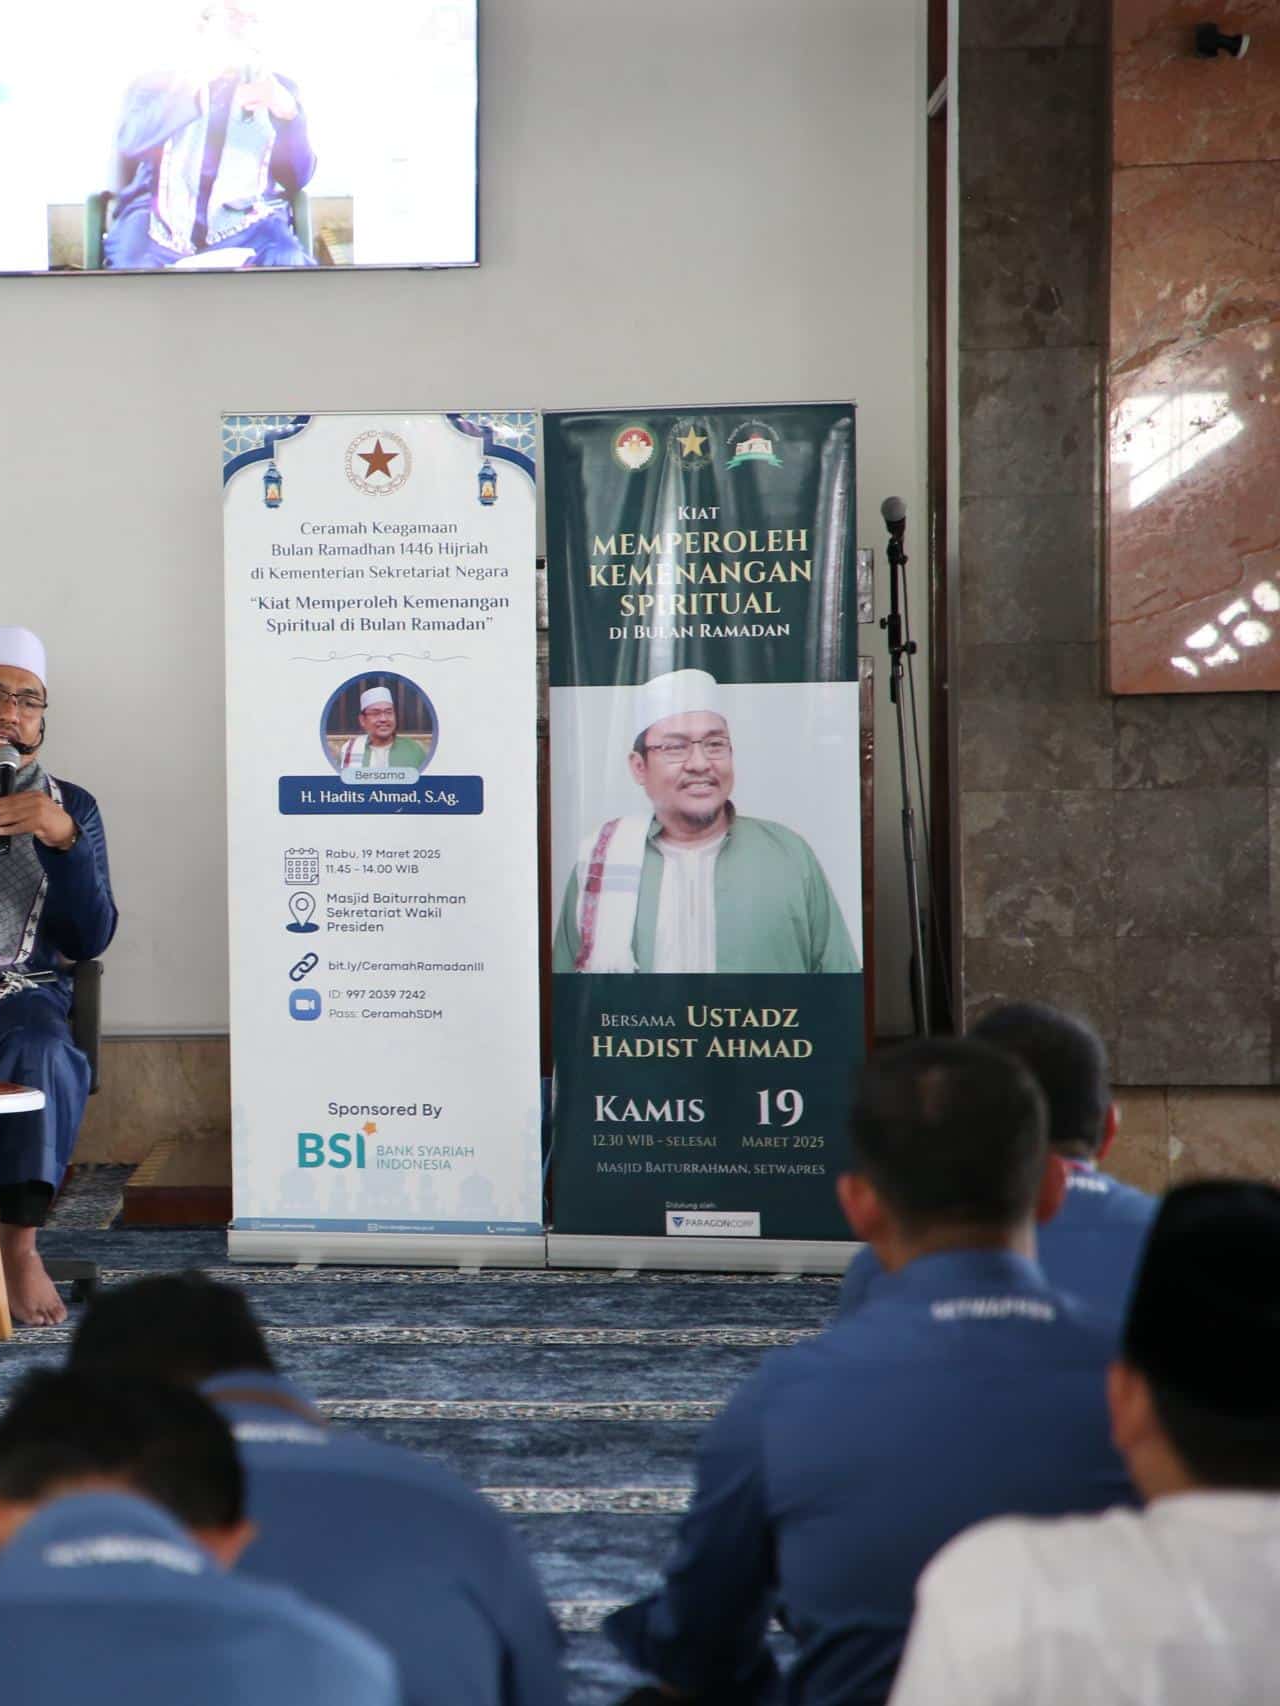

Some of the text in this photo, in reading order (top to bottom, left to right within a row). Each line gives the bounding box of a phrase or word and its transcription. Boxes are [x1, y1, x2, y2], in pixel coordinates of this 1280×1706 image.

[300, 521, 458, 538] Ceramah Keagamaan
[271, 542, 488, 559] Bulan Ramadhan 1446 Hijriah
[592, 529, 808, 557] MEMPEROLEH
[250, 564, 509, 582] di Kementerian Sekretariat Negara
[589, 559, 812, 587] KEMENANGAN
[296, 595, 398, 613] Memperoleh
[403, 595, 510, 612] Kemenangan
[620, 592, 781, 617] SPIRITUAL
[266, 617, 335, 635] Spiritual
[340, 617, 355, 632] di
[360, 617, 407, 632] Bulan
[355, 770, 405, 781] Bersama
[301, 790, 459, 806] H. Hadits Ahmad, S.Ag.
[362, 849, 372, 859] 19
[376, 849, 410, 859] Maret
[413, 849, 441, 859] 2025
[325, 864, 351, 874] 11.45
[363, 864, 392, 874] 14.00
[396, 864, 419, 874] WIB
[327, 893, 466, 906] Masjid Baiturrahman
[327, 907, 442, 918] Sekretariat Wakil
[327, 922, 384, 933] Presiden
[346, 989, 367, 999] 997
[369, 989, 396, 999] 2039
[399, 989, 426, 999] 7242
[361, 1009, 442, 1019] CeramahSDM
[687, 1005, 799, 1027] USTADZ
[592, 1036, 813, 1058] HADIST AHMAD
[328, 1102, 442, 1119] Sponsored By
[595, 1095, 705, 1122] KAMIS
[756, 1088, 804, 1127] 19
[593, 1134, 623, 1147] 12.30
[627, 1135, 654, 1147] WIB
[793, 1136, 824, 1148] 2025
[297, 1132, 366, 1169] BSI
[376, 1145, 475, 1157] BANK SYARIAH
[376, 1158, 451, 1170] INDONESIA
